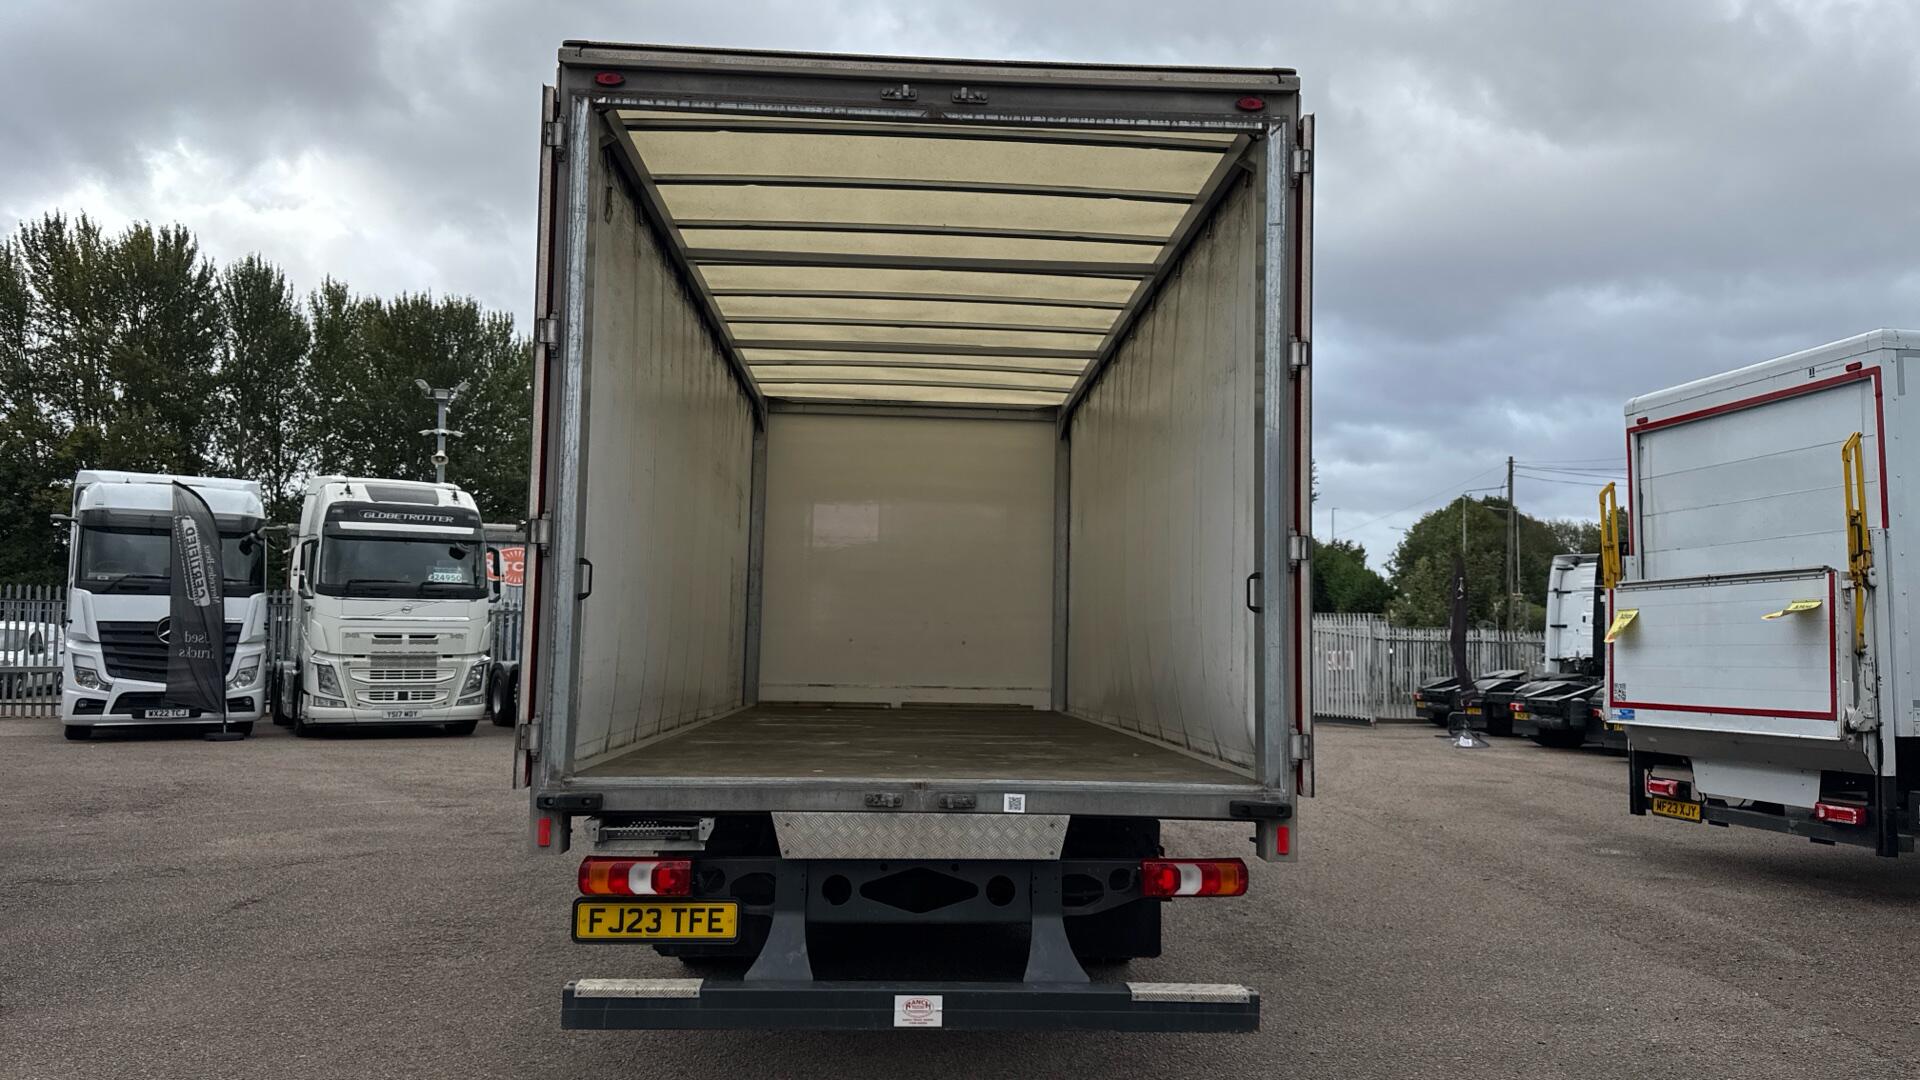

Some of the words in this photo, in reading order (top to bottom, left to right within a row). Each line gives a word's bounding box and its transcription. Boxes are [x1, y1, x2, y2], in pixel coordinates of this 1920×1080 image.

[363, 512, 454, 523] GLOBETROTTER
[1680, 803, 1697, 817] XJY
[588, 908, 662, 933] FJ23
[671, 908, 725, 933] TFE
[905, 999, 931, 1010] RANCH
